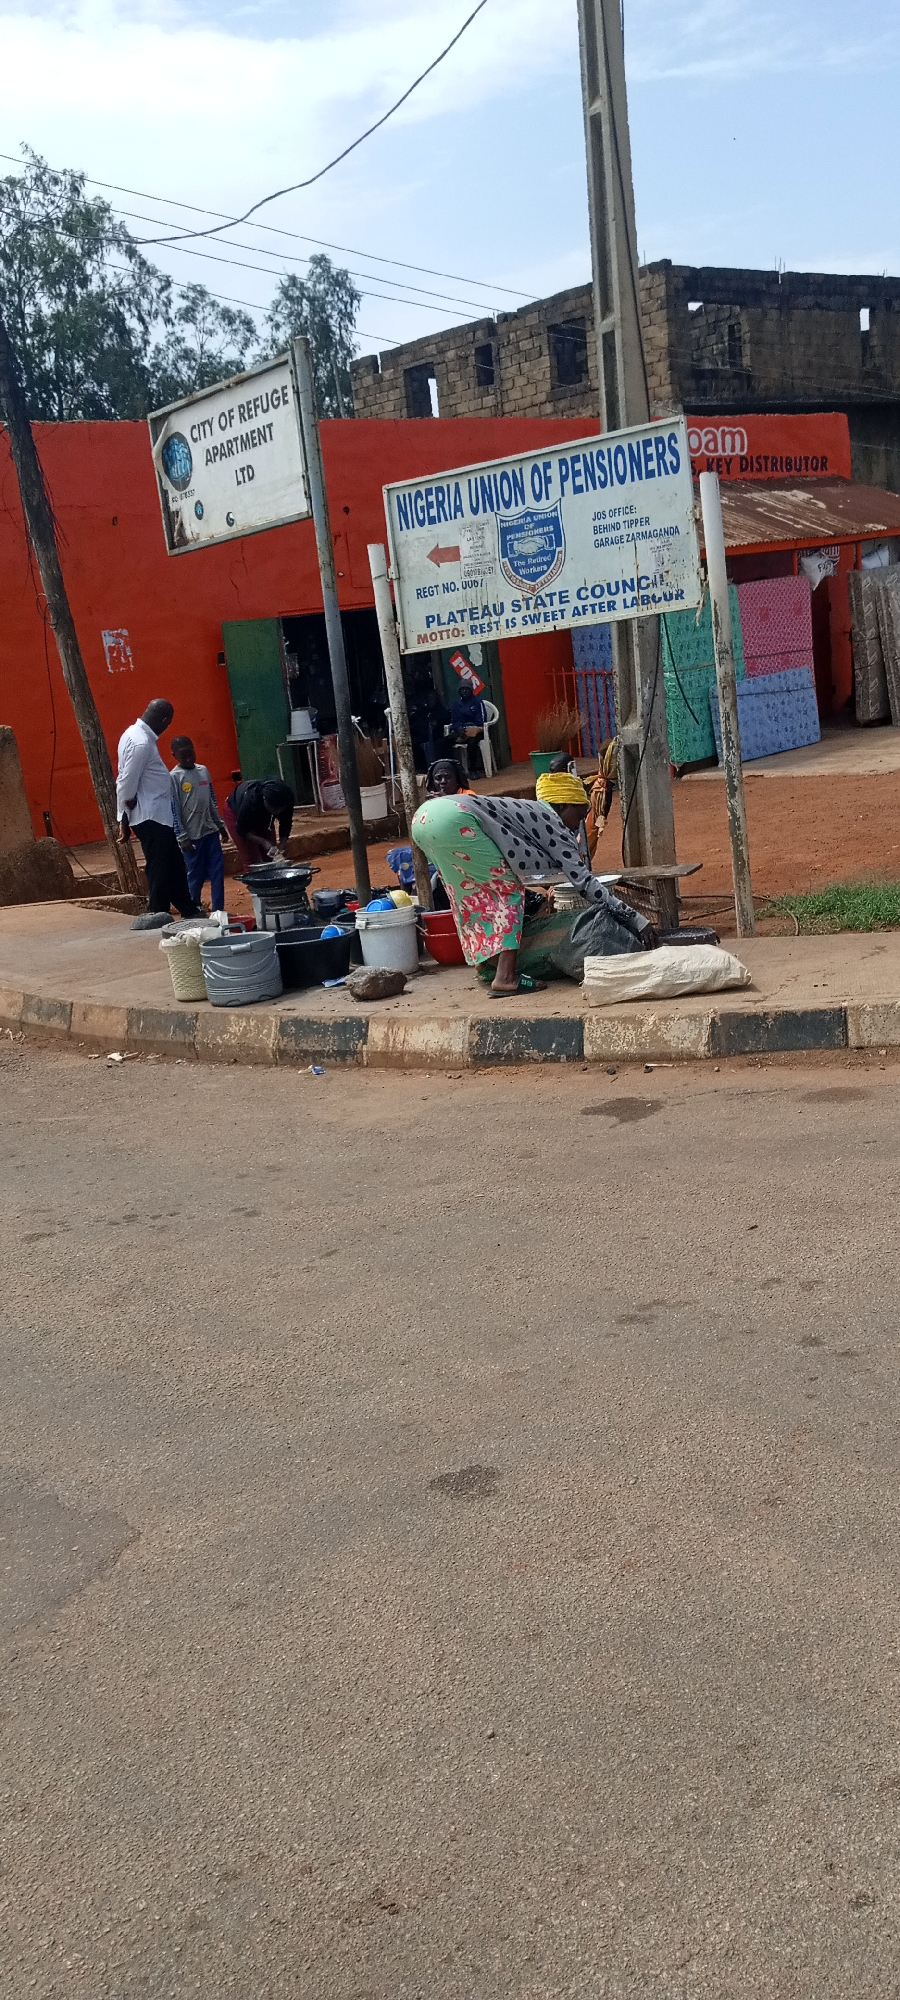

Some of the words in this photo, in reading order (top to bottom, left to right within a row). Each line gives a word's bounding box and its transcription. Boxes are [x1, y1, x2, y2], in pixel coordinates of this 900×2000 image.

[190, 416, 214, 444] CITY
[218, 408, 235, 432] OF
[238, 385, 289, 424] REFUGE
[205, 422, 274, 466] APARTMENT
[235, 464, 255, 486] LTD
[706, 458, 733, 475] KEY
[739, 455, 828, 473] DISTRIBUTOR
[396, 481, 464, 532] NIGERIA
[468, 468, 526, 516] UNION
[531, 461, 552, 503] OF
[558, 432, 680, 497] PENSIONERS
[500, 516, 531, 528] NIGERIA
[534, 511, 558, 520] UNION
[592, 510, 607, 521] JOS
[608, 505, 637, 518] OFFICE:
[506, 526, 554, 540] PENSIONERS
[593, 522, 621, 535] BEHIND
[623, 516, 650, 529] TIPPER
[594, 535, 624, 548] GARAGE
[626, 525, 680, 543] ZARMAGANDA
[528, 554, 552, 564] Retired
[519, 565, 548, 575] Workers
[416, 584, 439, 600] REGT
[442, 581, 459, 594] NO.
[417, 627, 465, 644] MOTTO:
[470, 621, 500, 635] REST
[505, 617, 516, 629] IS
[522, 608, 566, 626] SWEET
[572, 600, 617, 617] AFTER
[623, 589, 685, 609] LABOUR
[425, 601, 505, 628] PLATEAU
[511, 589, 570, 613] STATE
[452, 656, 480, 690] POS
